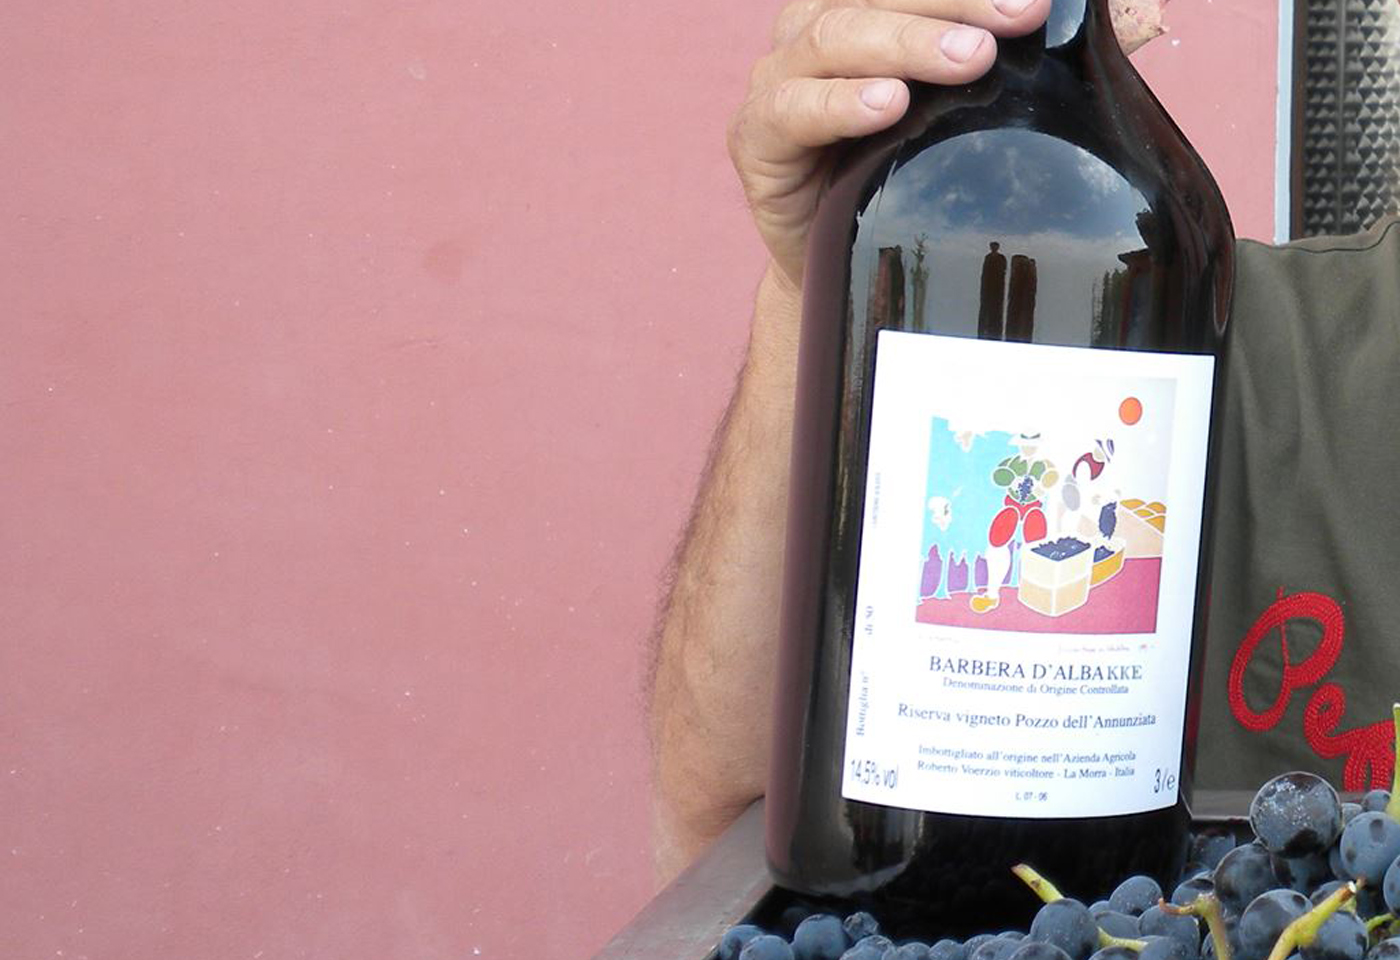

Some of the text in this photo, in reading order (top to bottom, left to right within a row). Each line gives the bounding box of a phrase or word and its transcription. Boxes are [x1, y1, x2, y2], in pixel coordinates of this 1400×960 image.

[929, 655, 1026, 680] BARBERA
[943, 676, 1129, 697] Denominazione di Origine Controllata
[898, 703, 1156, 730] Riserva vigneto Pozzo dell'Annunziata
[918, 744, 1137, 765] Imbottigliato all'origine nell'Azienda Agricola
[917, 760, 957, 774] Roberto
[961, 764, 1001, 777] Voerzio
[1004, 766, 1054, 779] viticoltore
[1064, 768, 1077, 779] La
[1079, 768, 1107, 779] Morra
[1114, 766, 1136, 778] Italia
